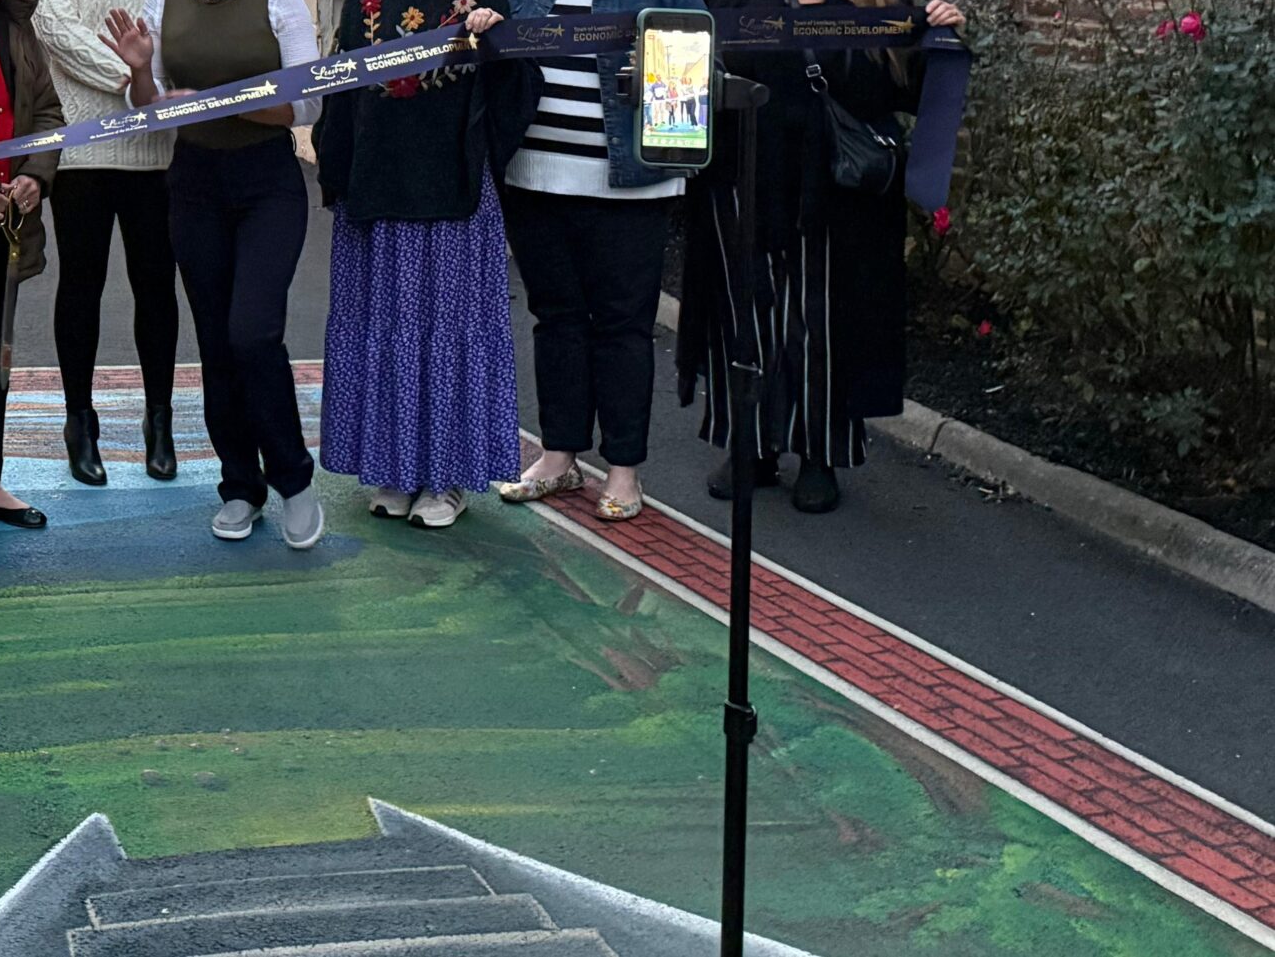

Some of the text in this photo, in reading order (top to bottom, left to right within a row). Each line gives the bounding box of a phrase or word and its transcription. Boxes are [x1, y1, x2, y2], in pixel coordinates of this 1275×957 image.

[573, 32, 623, 42] ECONOMIC
[793, 26, 842, 36] ECONOMIC
[366, 53, 415, 71] ECONOMIC
[157, 103, 207, 120] ECONOMIC
